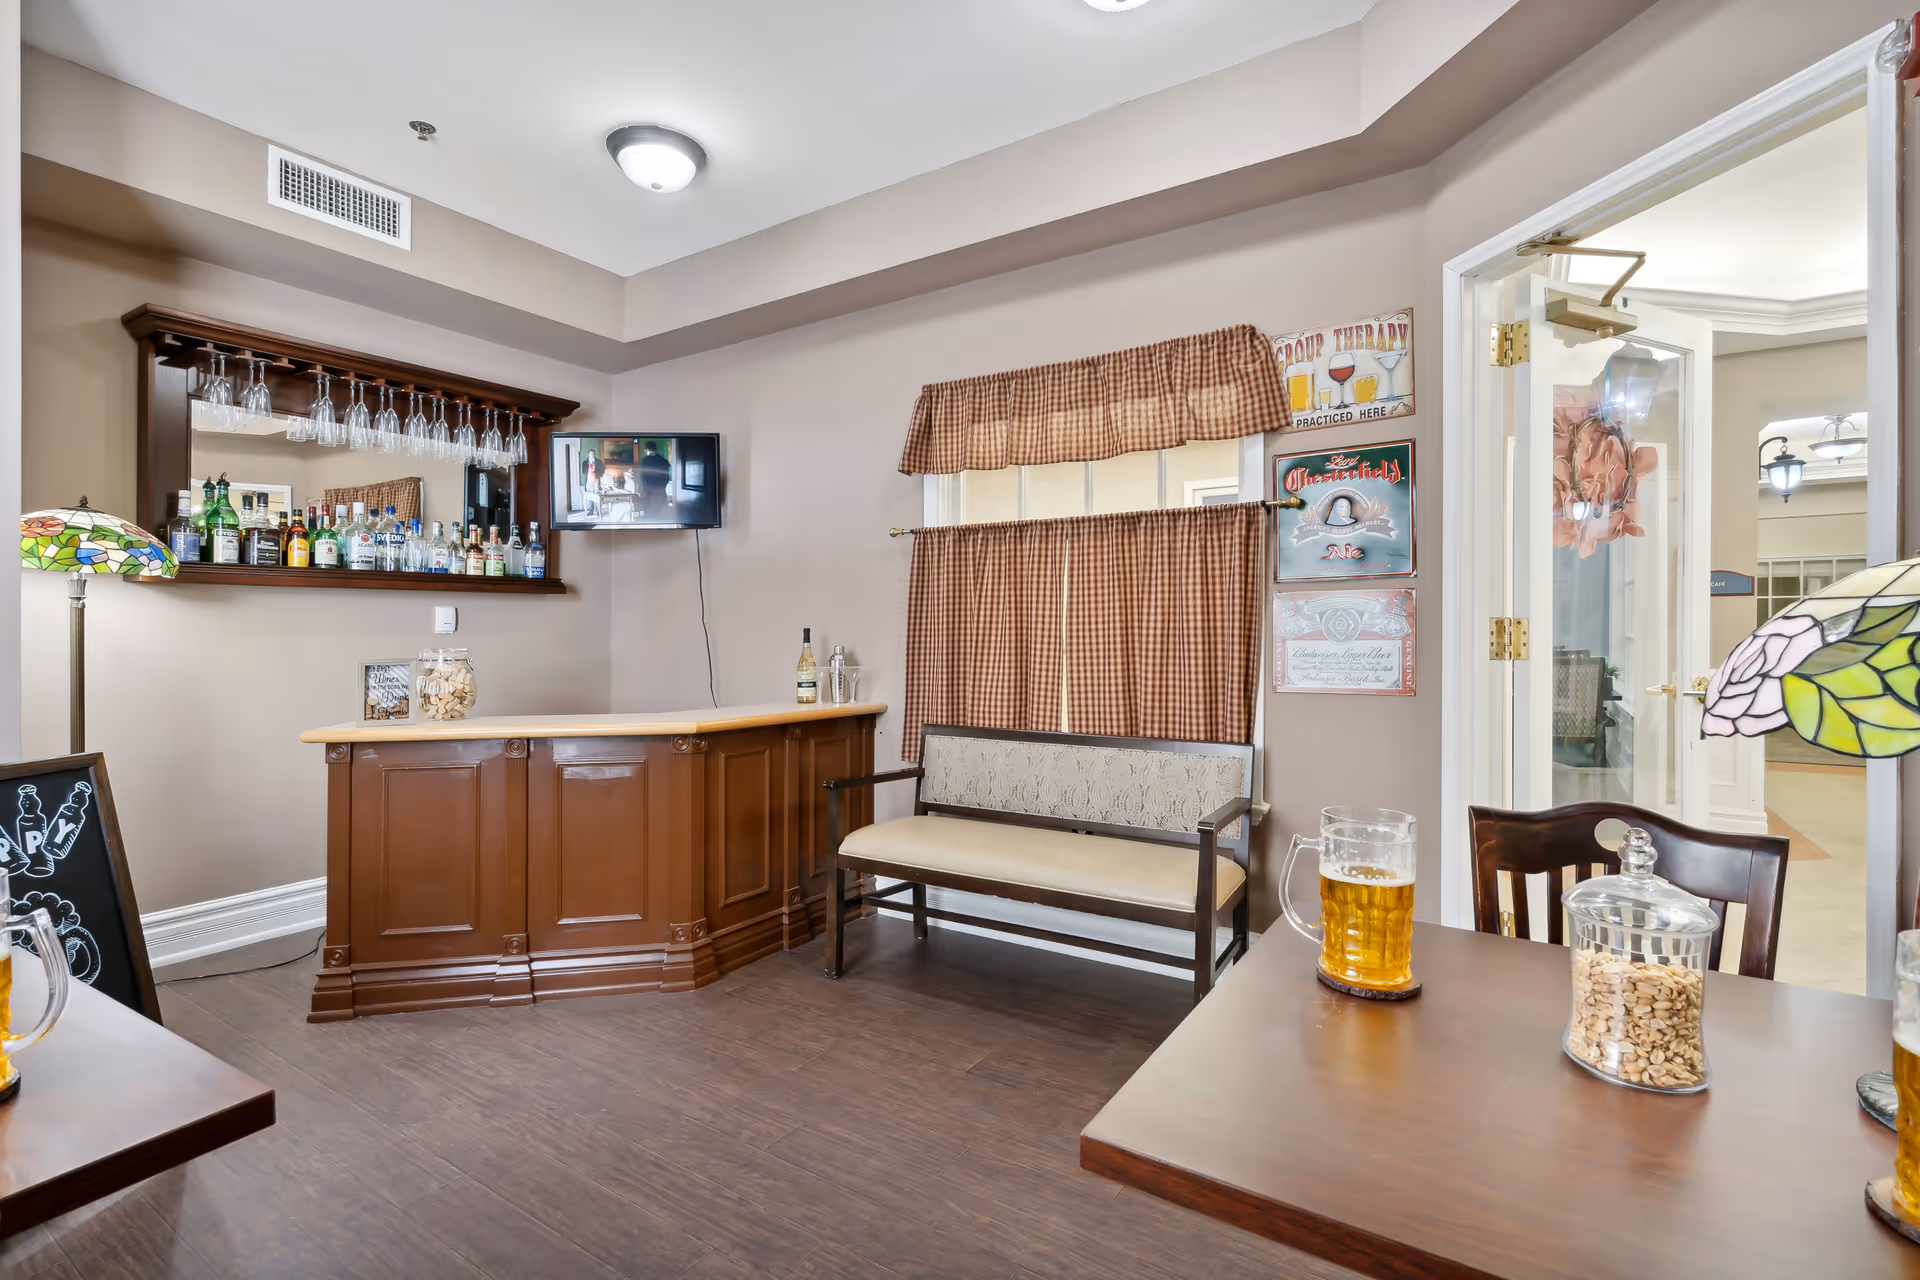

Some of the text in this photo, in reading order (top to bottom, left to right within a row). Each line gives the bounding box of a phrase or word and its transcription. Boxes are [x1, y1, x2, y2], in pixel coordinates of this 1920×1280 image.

[1275, 322, 1409, 378] GROUP THERAPY
[1296, 406, 1387, 429] PRACTICED HERE
[1284, 459, 1401, 494] Chesterfield
[1321, 544, 1364, 560] Ale
